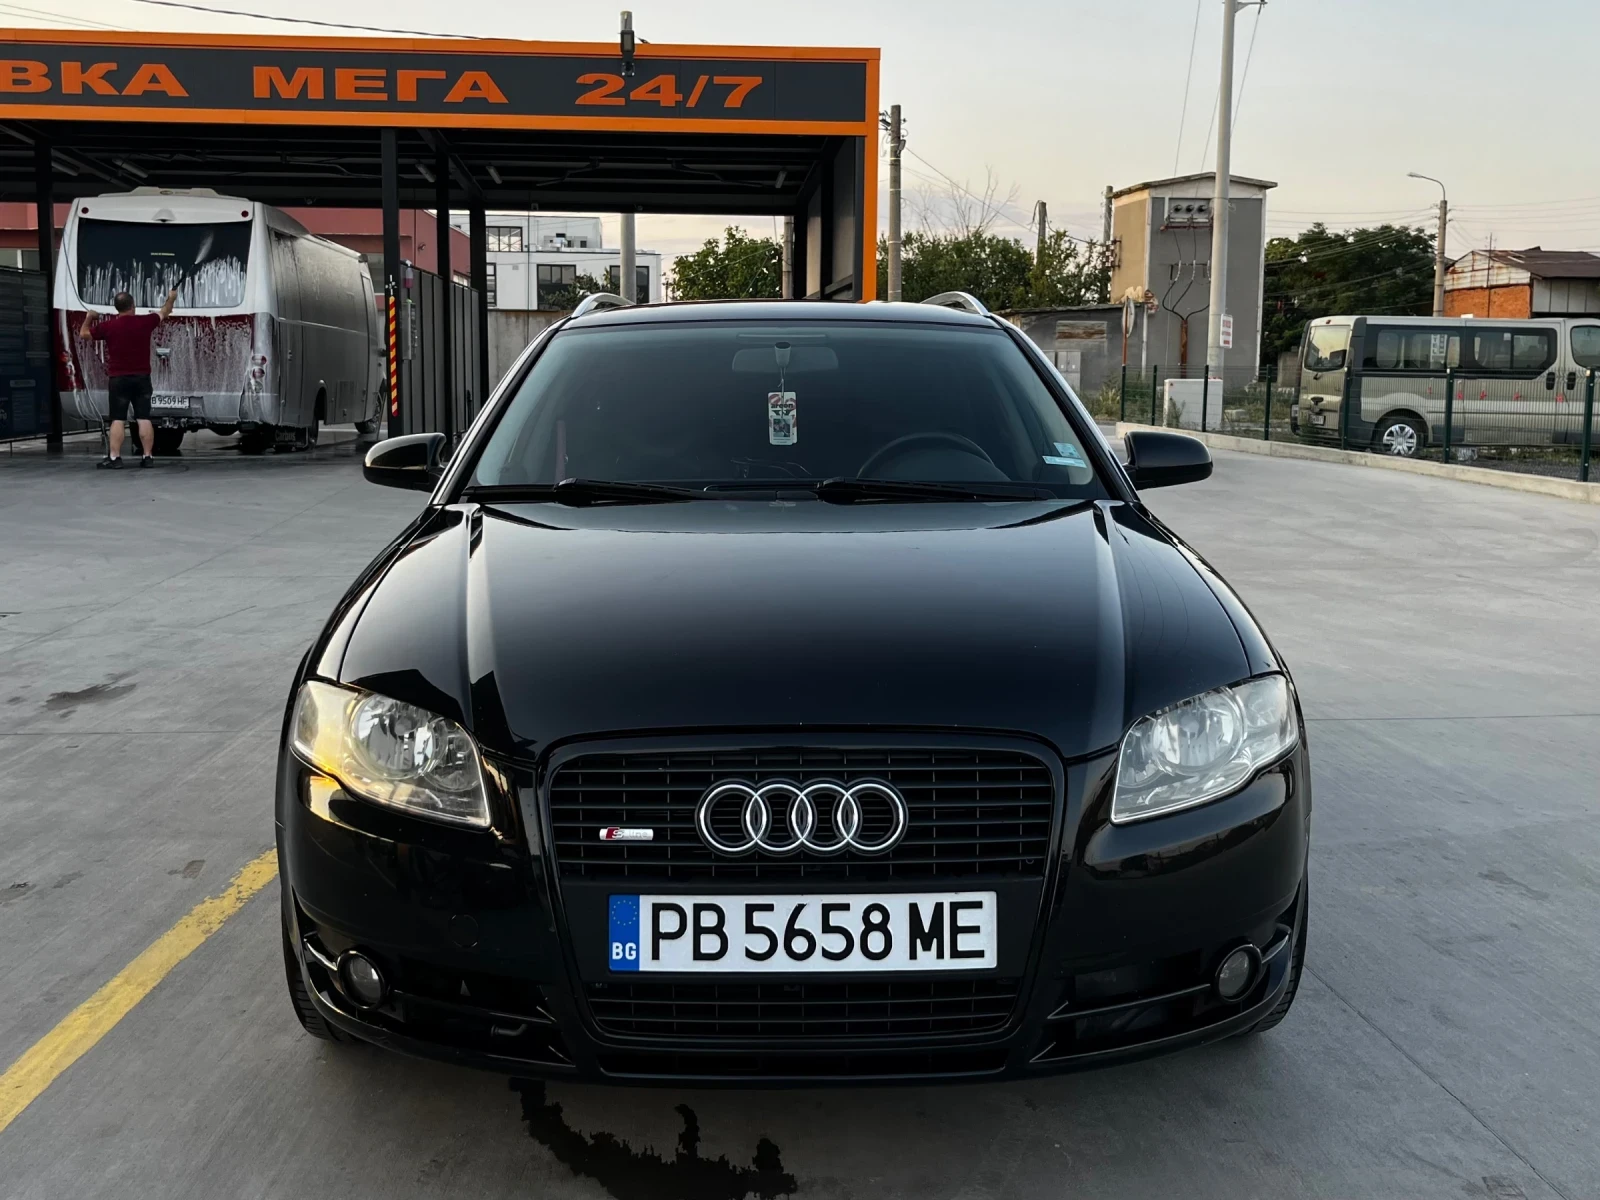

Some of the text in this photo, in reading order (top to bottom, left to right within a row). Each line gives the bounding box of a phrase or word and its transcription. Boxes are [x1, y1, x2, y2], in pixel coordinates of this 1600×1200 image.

[253, 66, 509, 104] МЕГА
[575, 73, 763, 108] 24/7
[612, 942, 637, 960] BG
[651, 900, 985, 961] PB 5658 ME
